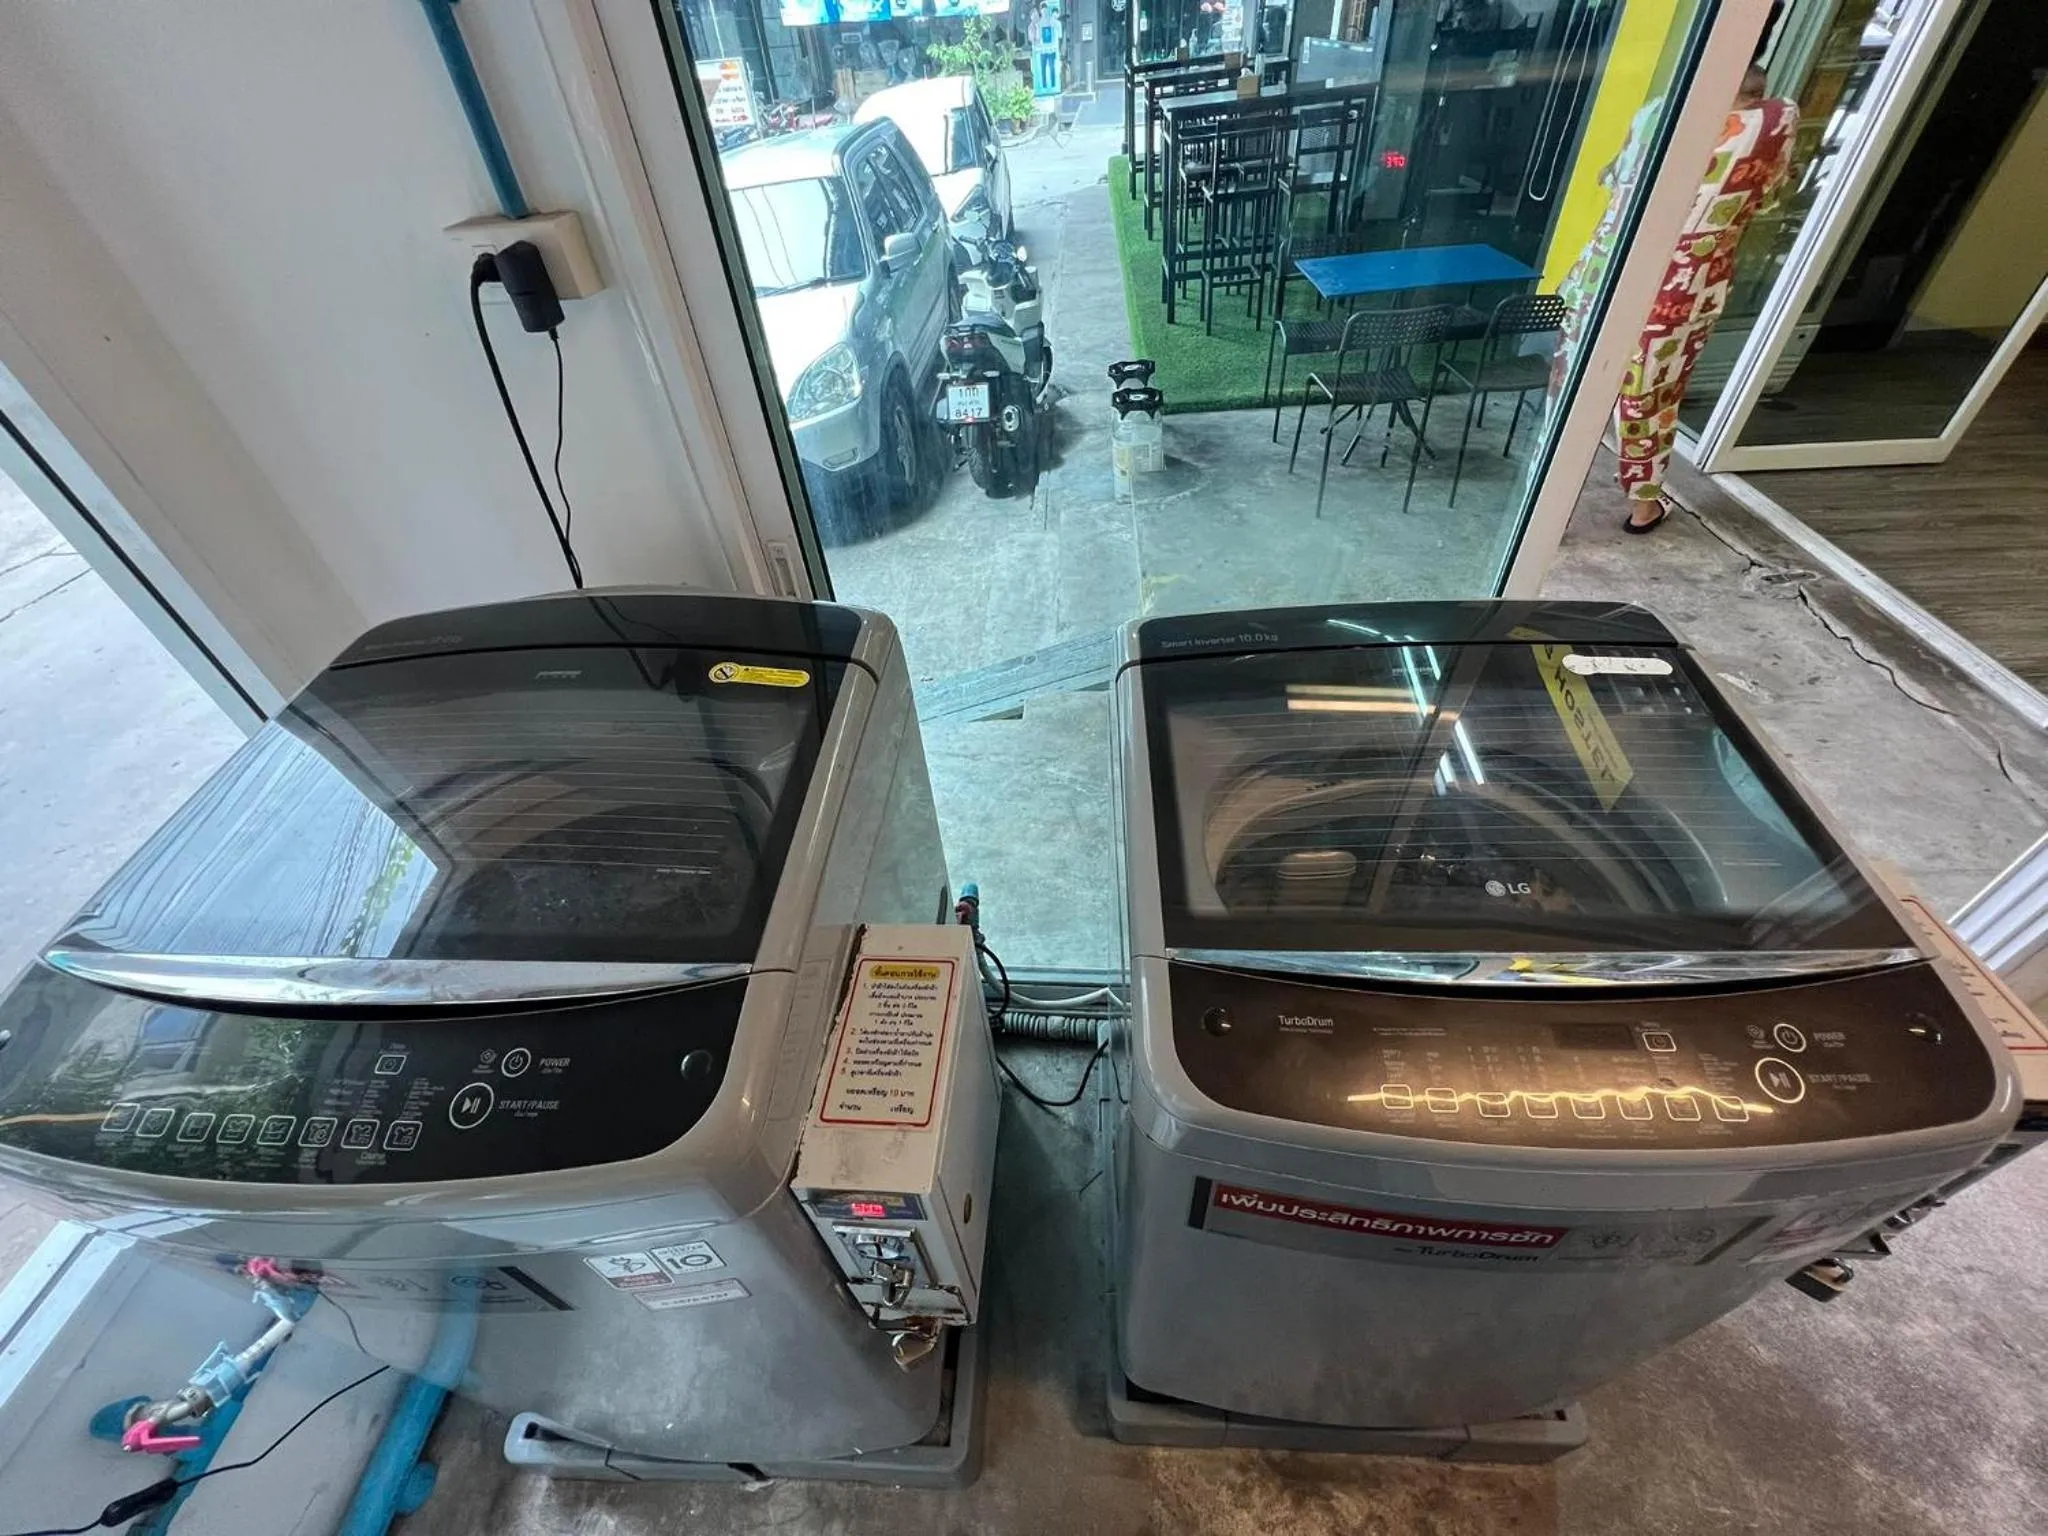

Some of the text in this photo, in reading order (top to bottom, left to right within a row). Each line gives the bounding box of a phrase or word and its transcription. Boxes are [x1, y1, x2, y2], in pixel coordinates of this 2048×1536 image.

[1506, 882, 1532, 894] LG
[1278, 1015, 1334, 1027] TurboDrum
[540, 1057, 571, 1067] POWER
[499, 1100, 560, 1110] START/PAUSE
[1221, 1193, 1555, 1245] เพิ่มประสิทธิภาพการซัก
[1417, 1245, 1539, 1263] TurboDrum
